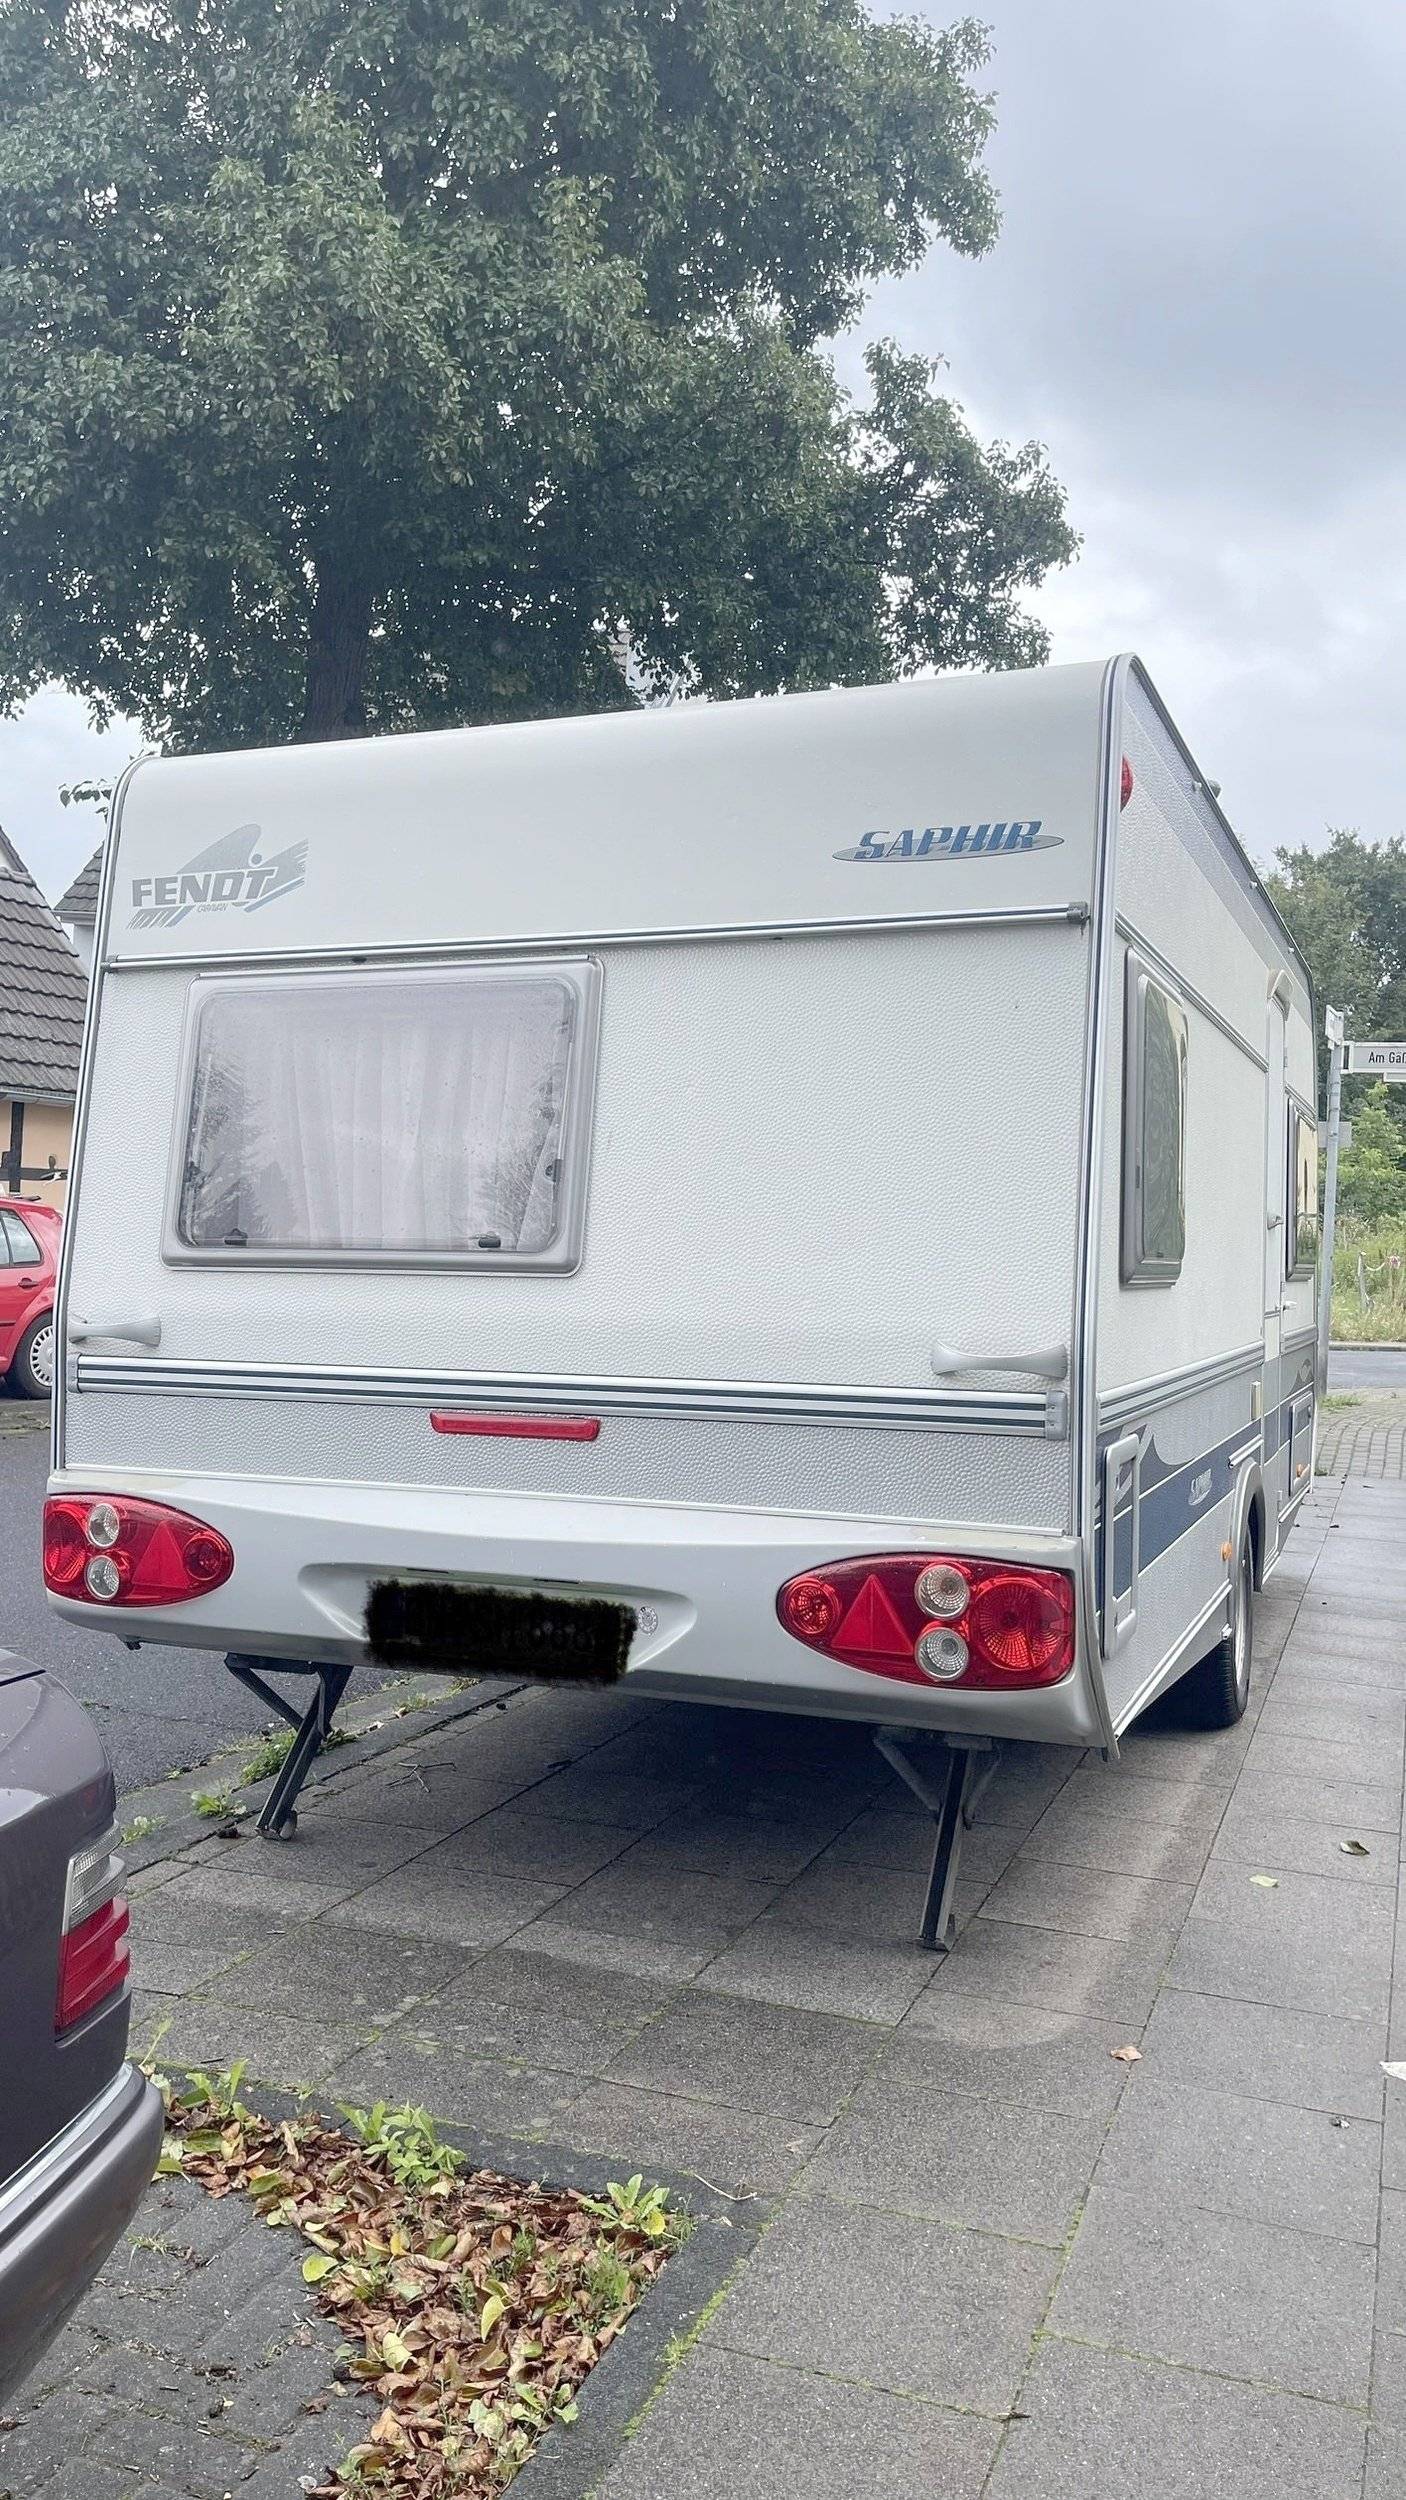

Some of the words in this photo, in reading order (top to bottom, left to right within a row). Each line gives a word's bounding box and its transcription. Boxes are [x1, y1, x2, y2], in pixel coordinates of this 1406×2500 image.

[853, 820, 1042, 860] SAPHIR
[132, 868, 276, 908] FENDT
[1368, 1051, 1385, 1063] Am
